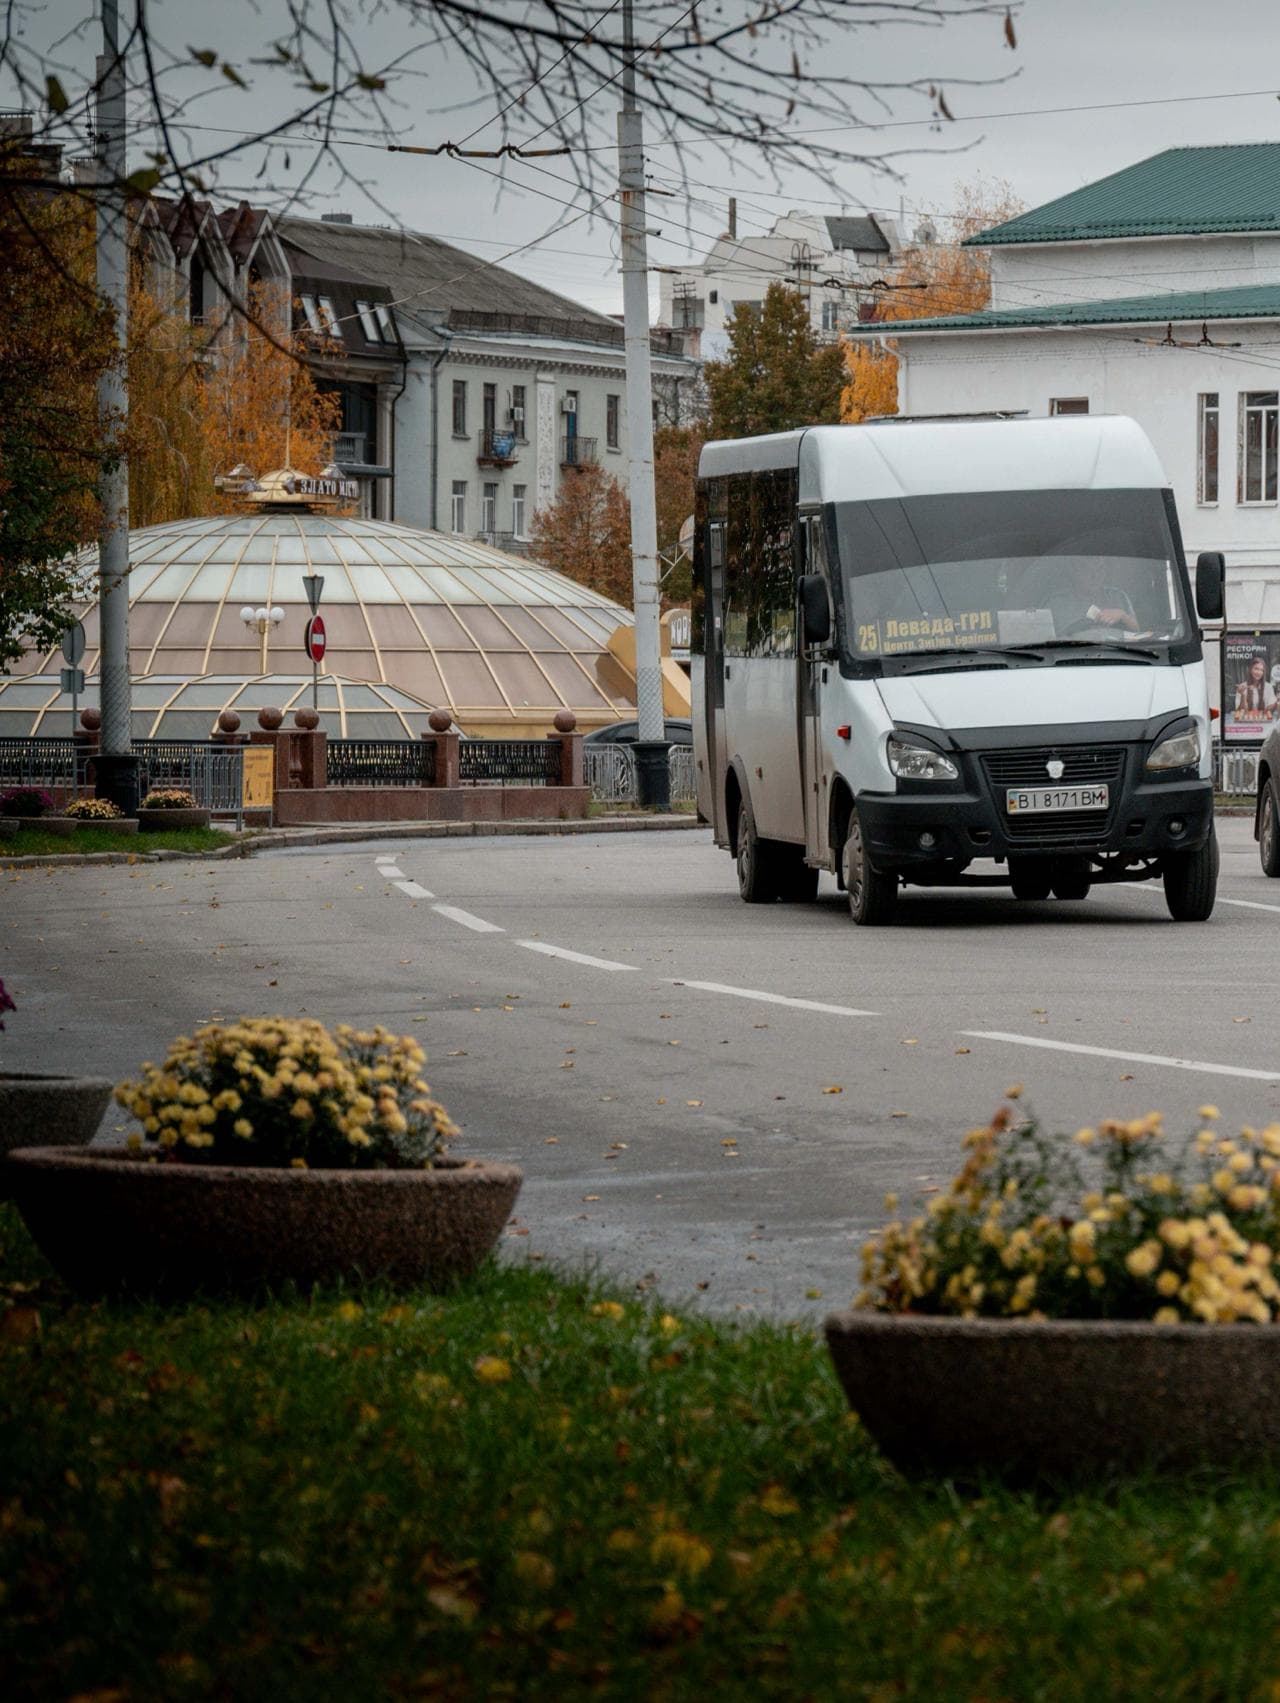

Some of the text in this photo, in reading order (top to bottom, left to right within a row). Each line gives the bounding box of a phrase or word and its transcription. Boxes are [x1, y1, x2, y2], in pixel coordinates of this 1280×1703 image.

[300, 479, 337, 496] ЗЛАТО
[858, 624, 878, 652] 25
[1226, 645, 1267, 653] РЕСТОРАН
